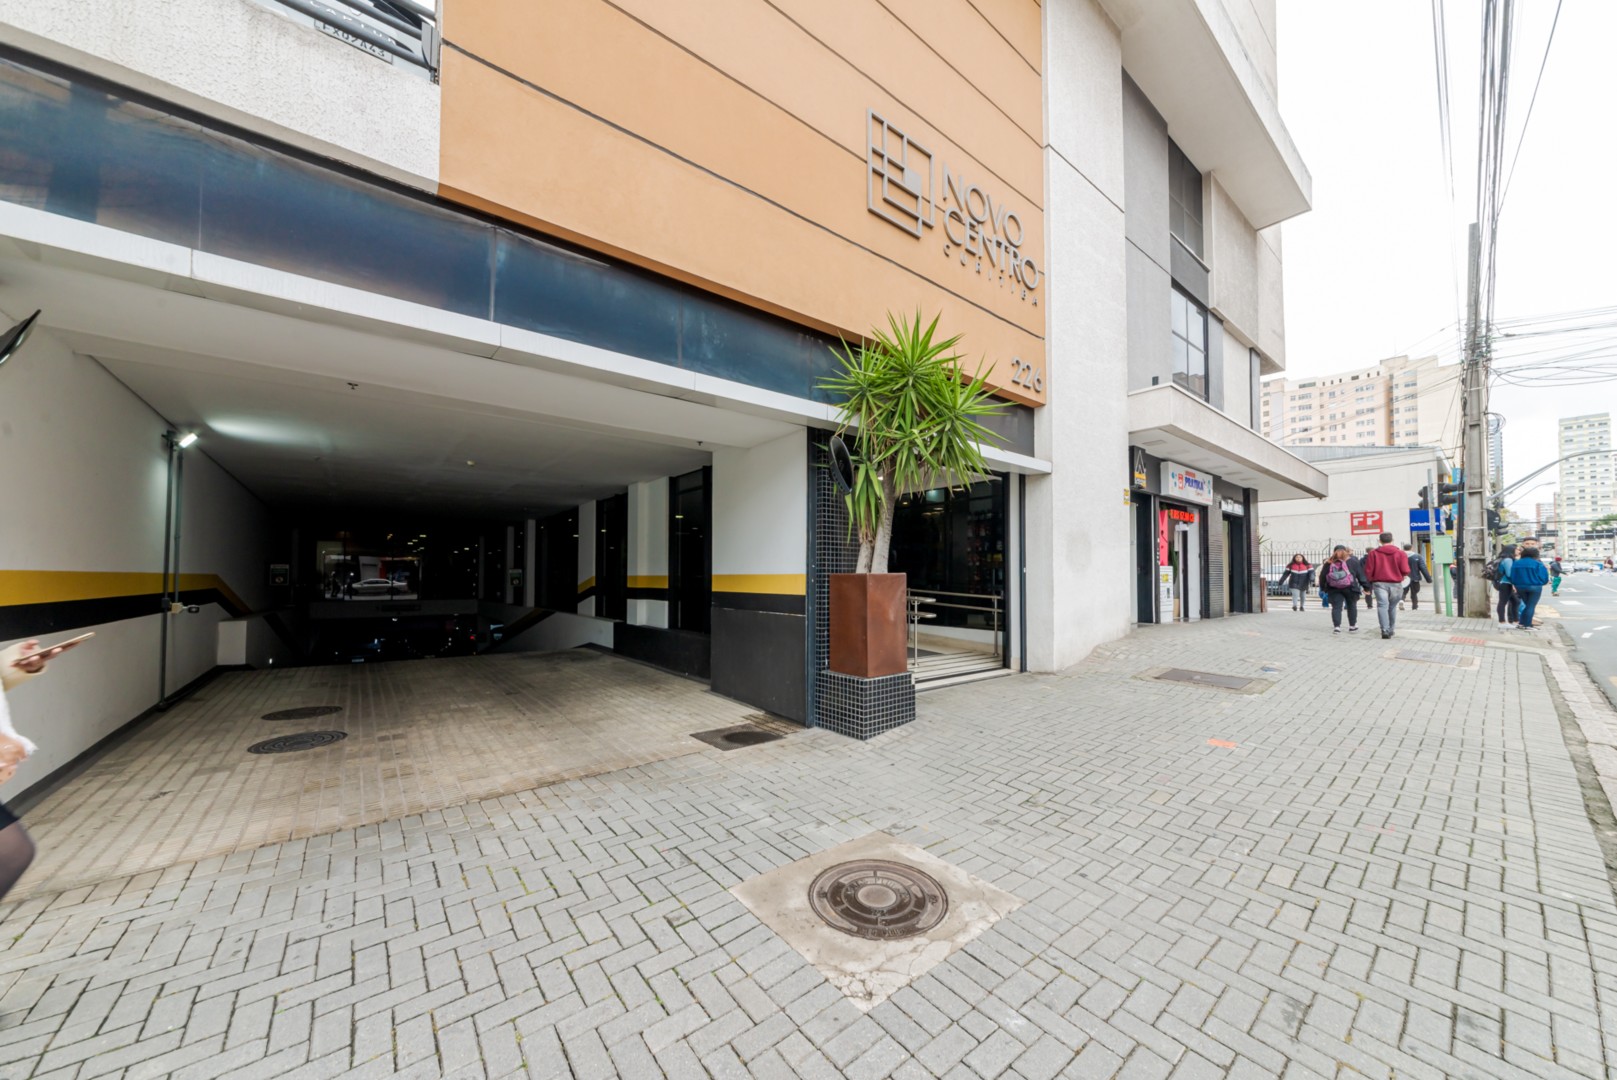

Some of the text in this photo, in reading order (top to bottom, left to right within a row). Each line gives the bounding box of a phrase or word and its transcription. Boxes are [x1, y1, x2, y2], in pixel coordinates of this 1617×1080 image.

[942, 161, 1025, 248] NOVO
[943, 206, 1039, 290] CENTRO
[943, 243, 1038, 307] CURITIBA
[1011, 355, 1043, 393] 226
